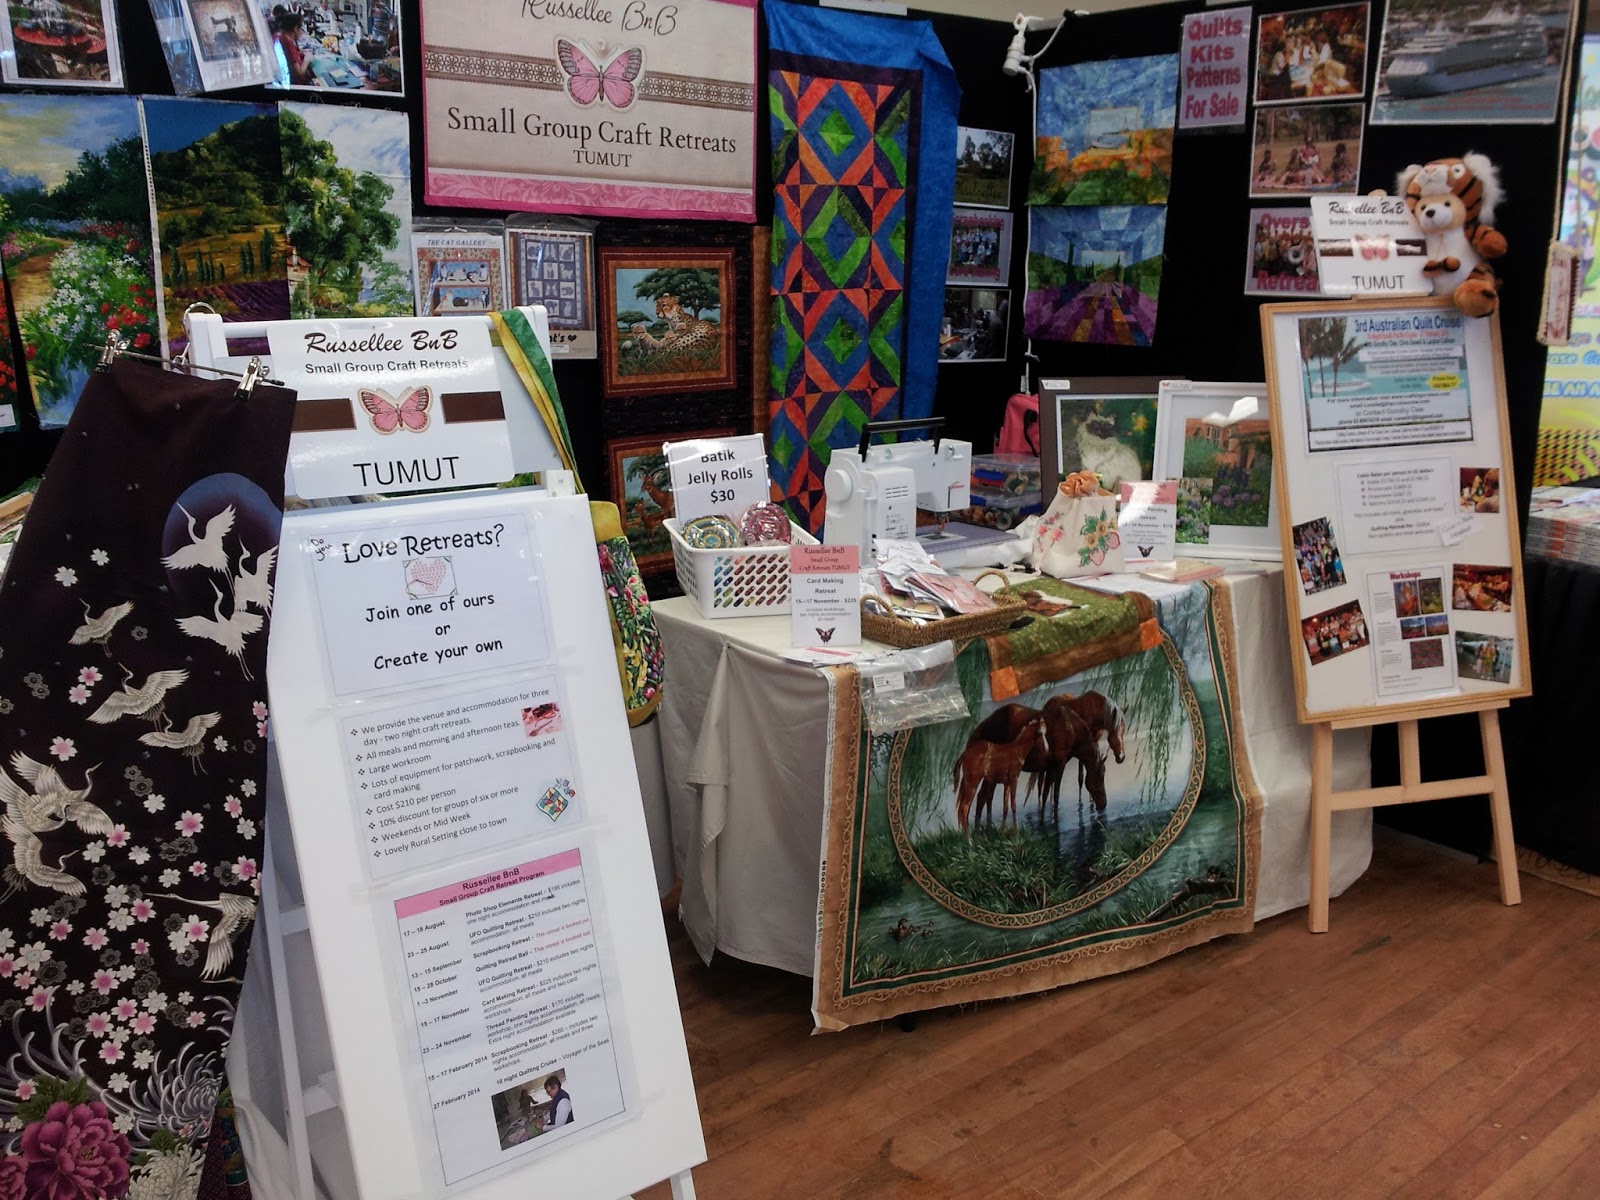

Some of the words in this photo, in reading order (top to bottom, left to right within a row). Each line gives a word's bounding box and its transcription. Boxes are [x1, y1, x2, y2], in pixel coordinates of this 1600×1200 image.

[522, 0, 612, 23] Russellee
[621, 1, 678, 36] BnB
[1188, 16, 1242, 41] Quilts
[1191, 45, 1234, 64] Kits
[1186, 66, 1240, 88] Patterns
[1186, 95, 1207, 119] For
[1210, 92, 1239, 116] Sale
[448, 107, 515, 134] Small
[524, 114, 592, 148] Group
[598, 121, 652, 146] Craft
[660, 127, 736, 153] Retreats
[574, 150, 631, 167] TUMUT
[1328, 202, 1376, 214] Ruellee
[1381, 202, 1404, 214] BnB
[1260, 214, 1310, 228] Overs
[1256, 271, 1318, 290] Retrea
[1352, 276, 1404, 289] TUMUT
[1355, 320, 1368, 332] 3rd
[1369, 318, 1412, 331] Australian
[1413, 316, 1432, 330] Quilt
[1434, 316, 1461, 328] Cruise
[304, 332, 404, 354] Russellee
[411, 330, 458, 350] BnB
[305, 363, 340, 374] Small
[344, 362, 384, 375] Group
[387, 360, 416, 372] Craft
[420, 358, 469, 370] Retreats
[353, 456, 460, 487] TUMUT
[688, 471, 716, 484] Jelly
[721, 467, 753, 480] Rolls
[711, 490, 734, 504] $30
[310, 538, 324, 547] Do
[314, 543, 332, 561] you
[343, 539, 397, 563] Love
[400, 523, 504, 556] Retreats?
[1389, 572, 1420, 580] Workshops
[366, 606, 400, 622] Join
[407, 604, 432, 616] one
[440, 596, 455, 612] of
[463, 594, 494, 608] ours
[435, 623, 451, 636] or
[374, 652, 429, 670] Create
[435, 645, 468, 664] your
[476, 639, 503, 654] own
[361, 725, 375, 734] We
[377, 718, 406, 733] provide
[407, 715, 420, 724] the
[422, 712, 444, 721] venue
[446, 707, 460, 715] and
[461, 694, 518, 712] accommodation
[531, 688, 549, 697] three
[363, 737, 378, 748] day
[384, 732, 399, 741] two
[401, 728, 420, 739] night
[422, 724, 439, 733] craft
[440, 716, 471, 728] retreats.
[366, 752, 377, 760] All
[378, 746, 401, 757] meals
[402, 743, 417, 751] and
[418, 735, 450, 750] morning
[451, 732, 464, 740] and
[466, 723, 501, 737] afternoon
[503, 719, 520, 728] teas.
[369, 763, 390, 776] Large
[391, 753, 431, 768] workroom
[371, 778, 390, 788] Lots
[399, 766, 440, 783] equipment
[441, 763, 452, 771] for
[453, 752, 494, 770] patchwork,
[495, 741, 541, 760] scrapbooking
[542, 738, 555, 746] and
[373, 790, 390, 799] card
[392, 782, 420, 797] making
[376, 803, 393, 813] Cost
[395, 798, 414, 808] $210
[416, 796, 429, 805] per
[430, 789, 456, 801] person
[379, 817, 395, 827] 10%
[397, 808, 429, 822] discount
[431, 805, 442, 813] for
[444, 800, 469, 812] groups
[479, 793, 489, 801] six
[500, 787, 518, 795] more
[381, 825, 421, 841] Weekends
[433, 818, 448, 827] Mid
[450, 812, 470, 823] Week
[384, 843, 409, 857] Lovely
[410, 837, 430, 848] Rural
[432, 829, 458, 844] Setting
[458, 824, 477, 835] close
[478, 821, 487, 829] to
[488, 816, 507, 826] town
[439, 895, 457, 906] Small
[458, 889, 478, 901] Group
[479, 884, 494, 894] Craft
[495, 877, 518, 889] Retreat
[518, 869, 544, 883] Program
[462, 872, 501, 890] Russellee
[502, 867, 519, 878] BnB
[424, 919, 445, 932] August
[482, 923, 504, 935] Quilting
[504, 916, 524, 926] Retreat
[428, 940, 449, 953] August
[482, 997, 495, 1006] Card
[496, 990, 515, 1003] Making
[516, 983, 535, 994] Retreat
[441, 1006, 469, 1020] November
[486, 1020, 505, 1031] Thread
[505, 1012, 527, 1025] Painting
[528, 1004, 547, 1015] Retreat
[441, 1092, 466, 1108] February
